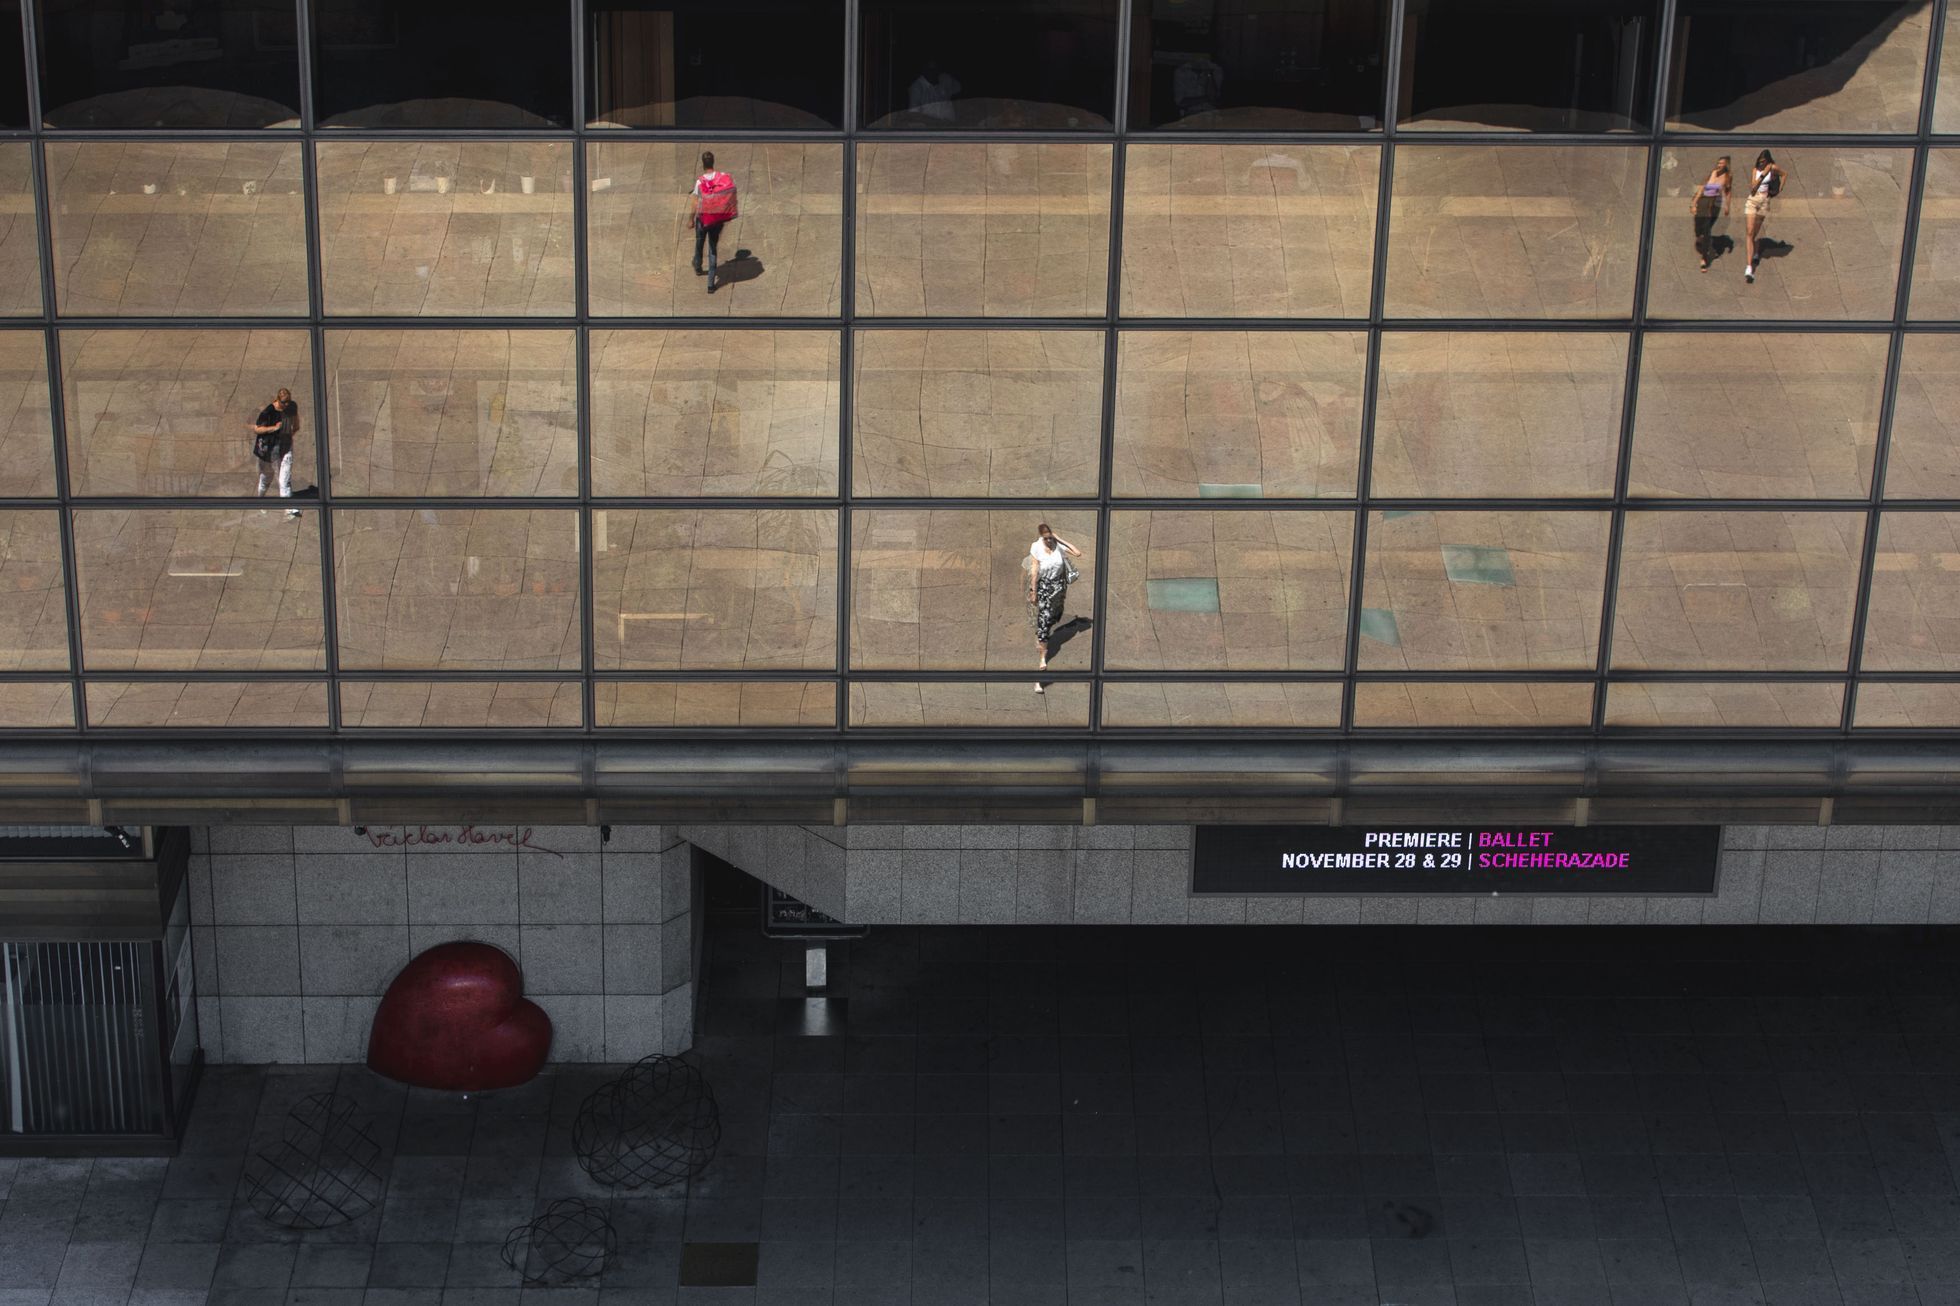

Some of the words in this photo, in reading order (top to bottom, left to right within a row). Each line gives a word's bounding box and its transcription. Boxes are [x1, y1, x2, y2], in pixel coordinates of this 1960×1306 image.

[1364, 832, 1462, 848] PREMIERE
[1478, 832, 1554, 848] BALLET
[1281, 852, 1391, 869] NOVEMBER
[1394, 852, 1416, 869] 28
[1422, 852, 1436, 869] &
[1439, 852, 1462, 869] 29
[1478, 852, 1631, 869] SCHEHERAZADE
